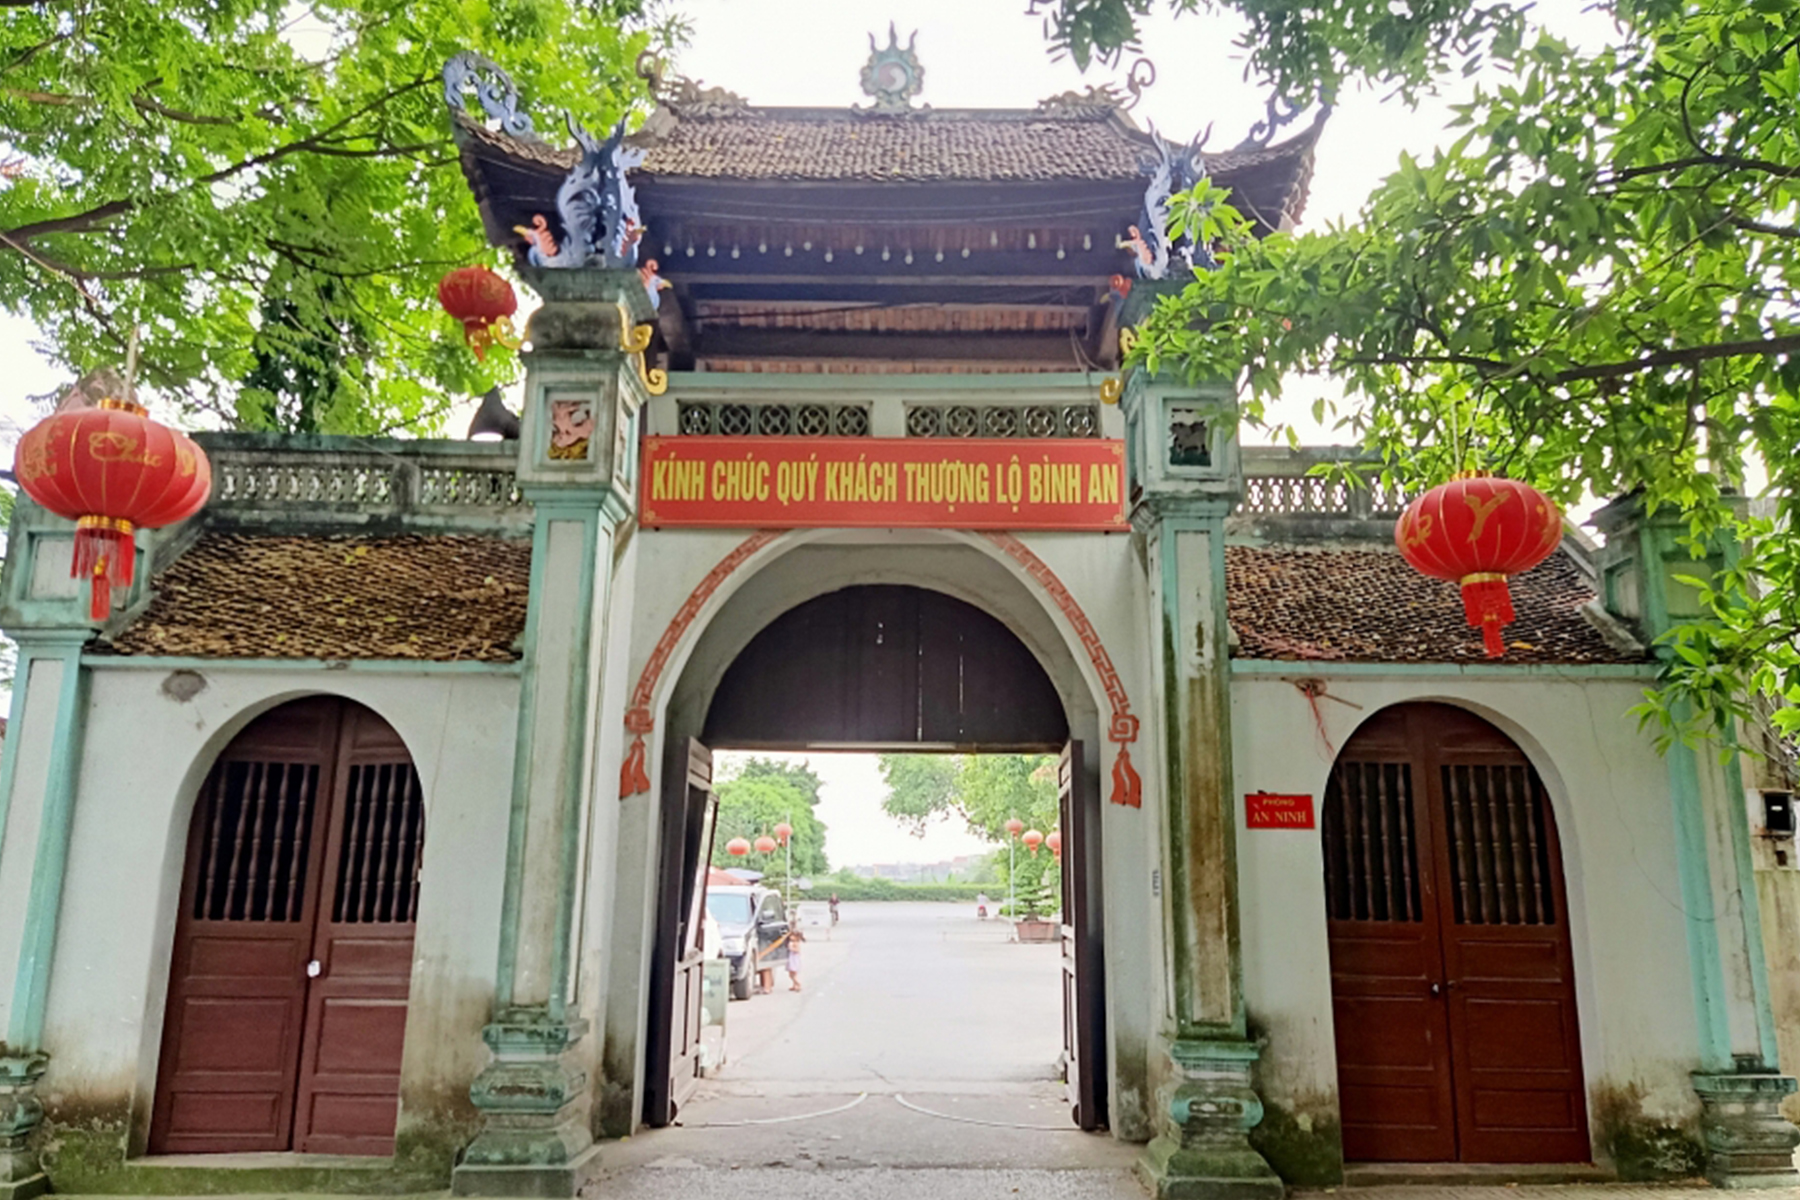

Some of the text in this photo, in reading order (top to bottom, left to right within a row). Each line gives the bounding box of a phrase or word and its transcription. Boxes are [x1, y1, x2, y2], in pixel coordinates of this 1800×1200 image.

[652, 451, 1119, 513] KÍNH CHÚC QUÝ KHÁCH THƯỢNG LỘ BÌNH AN
[1253, 811, 1307, 823] AN NINH
